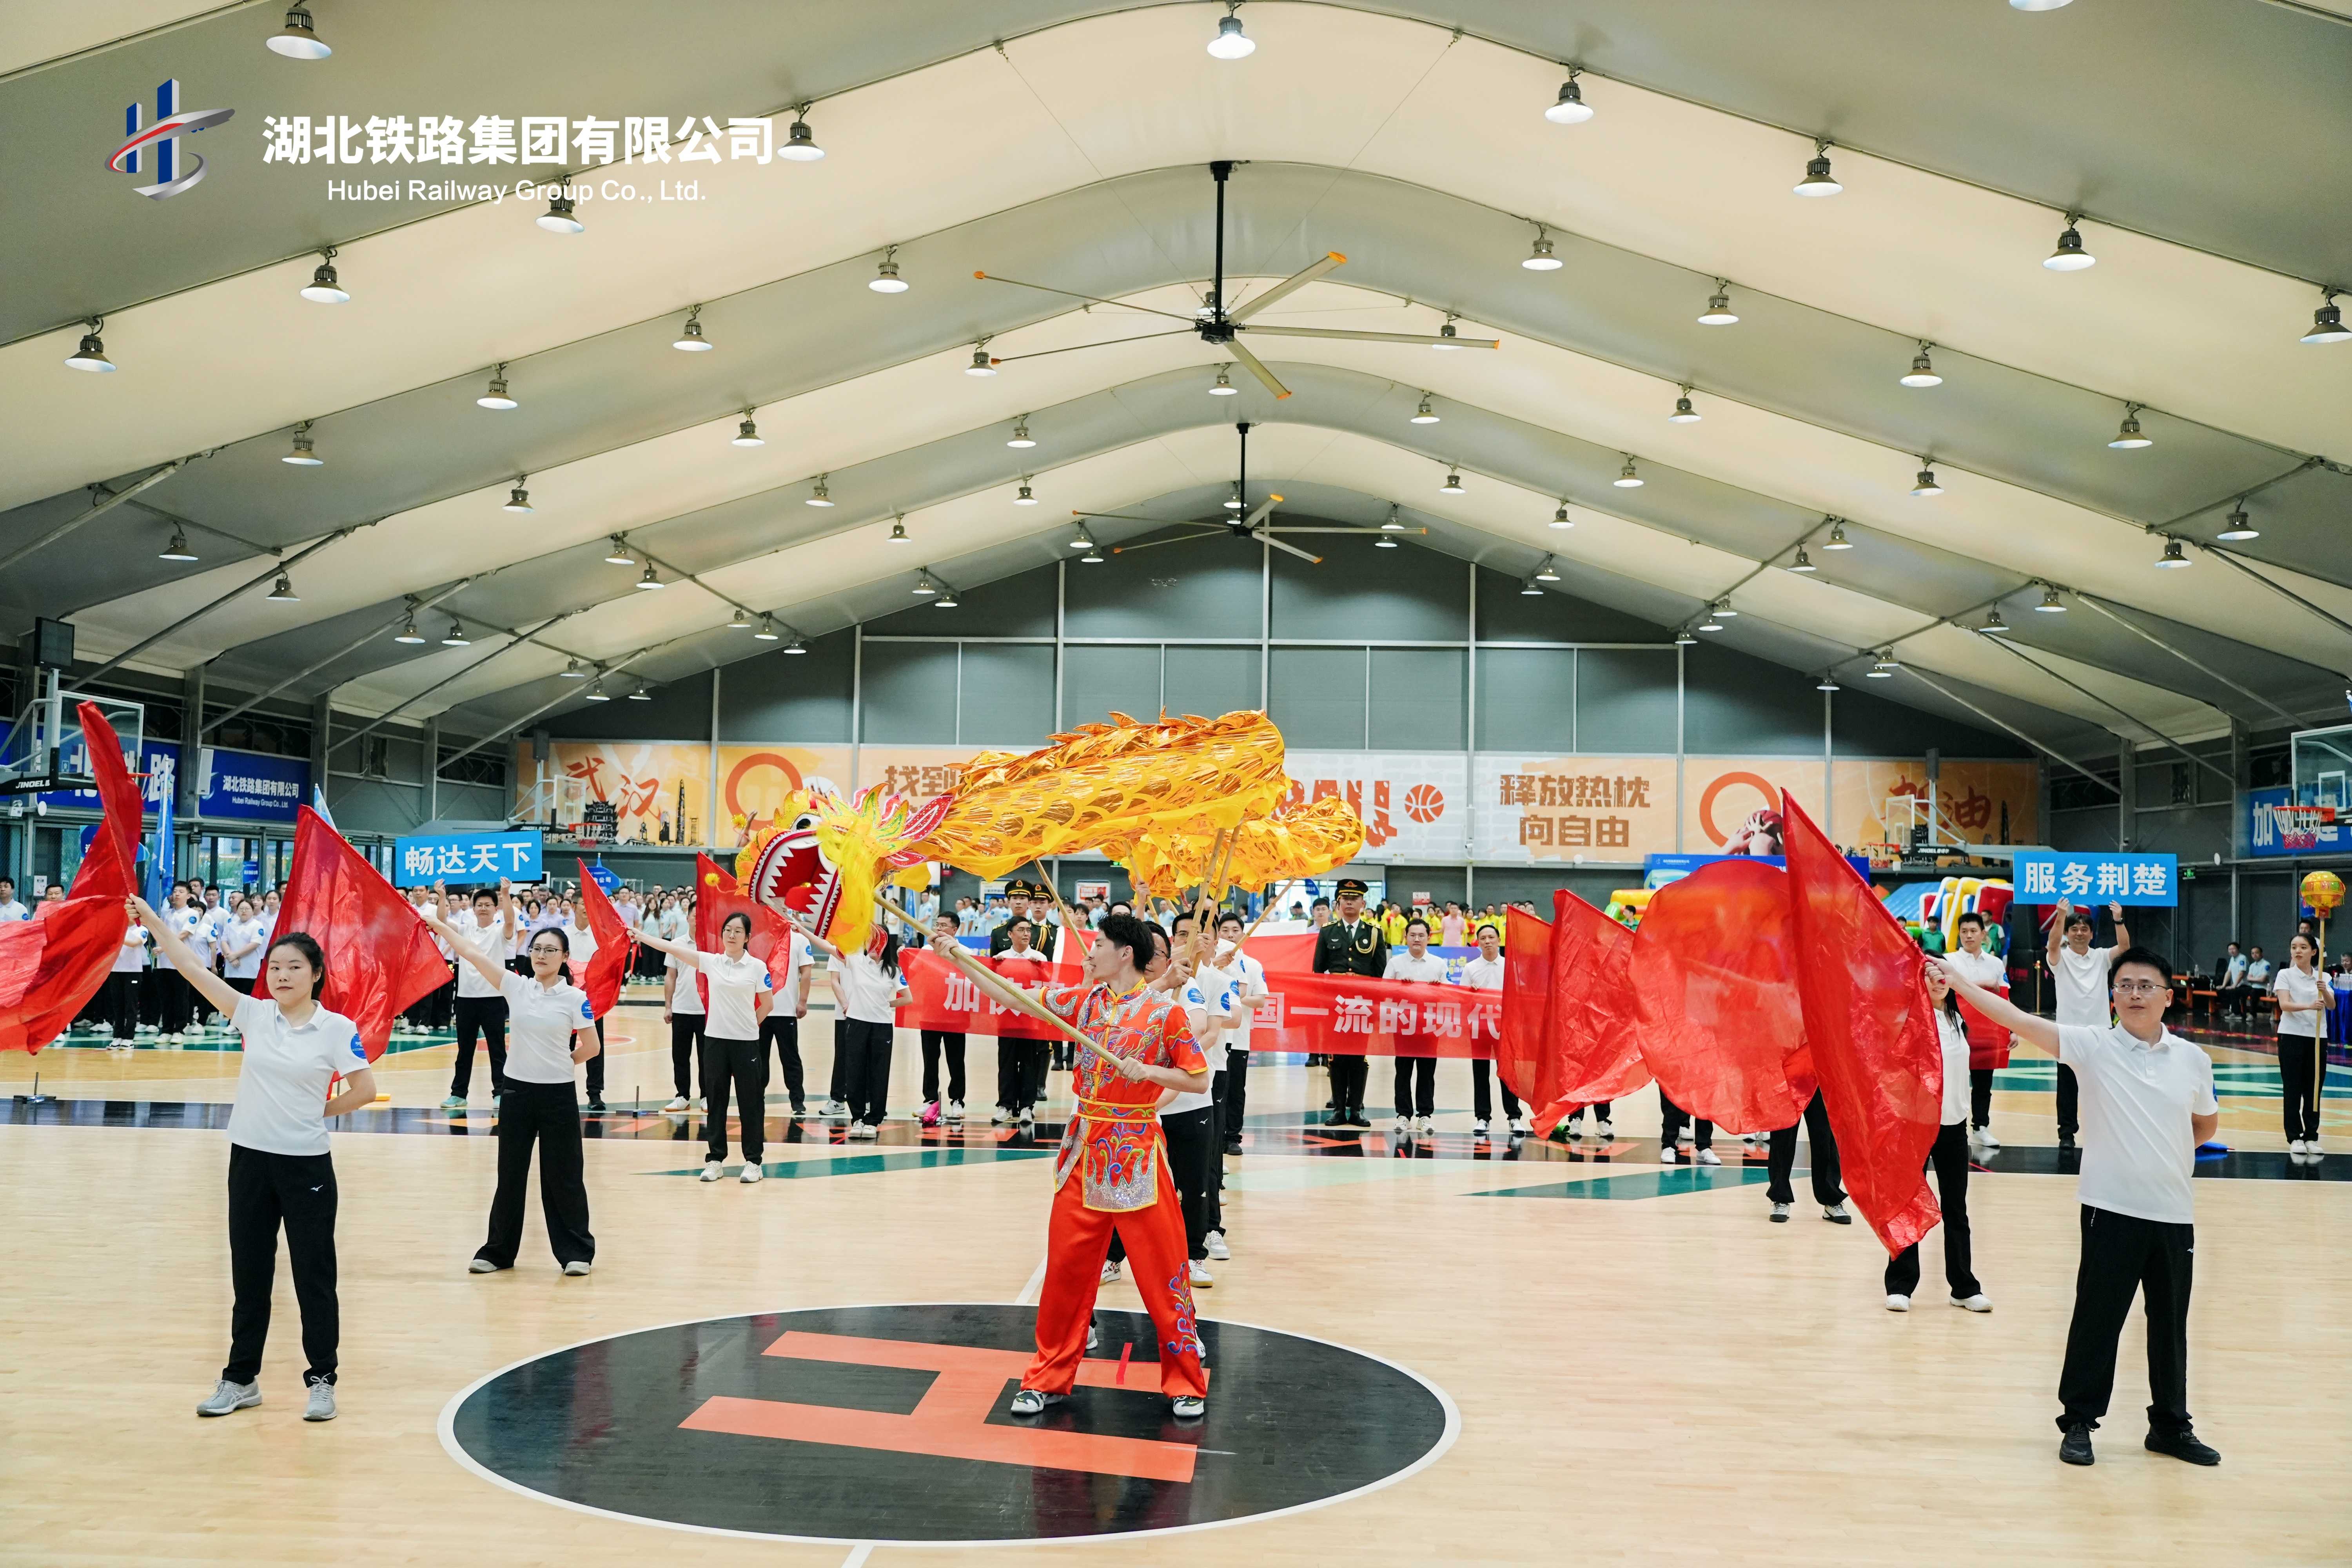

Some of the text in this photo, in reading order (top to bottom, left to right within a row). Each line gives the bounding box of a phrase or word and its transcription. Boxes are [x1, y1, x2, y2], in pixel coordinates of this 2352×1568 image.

[223, 775, 299, 798] 湖北铁路集团有限公司
[885, 766, 956, 796] 找到
[244, 797, 260, 807] Railway
[261, 799, 273, 807] Group
[1519, 815, 1629, 848] 向自由
[405, 842, 532, 877] 畅达天下
[2024, 862, 2167, 896] 服务荆楚
